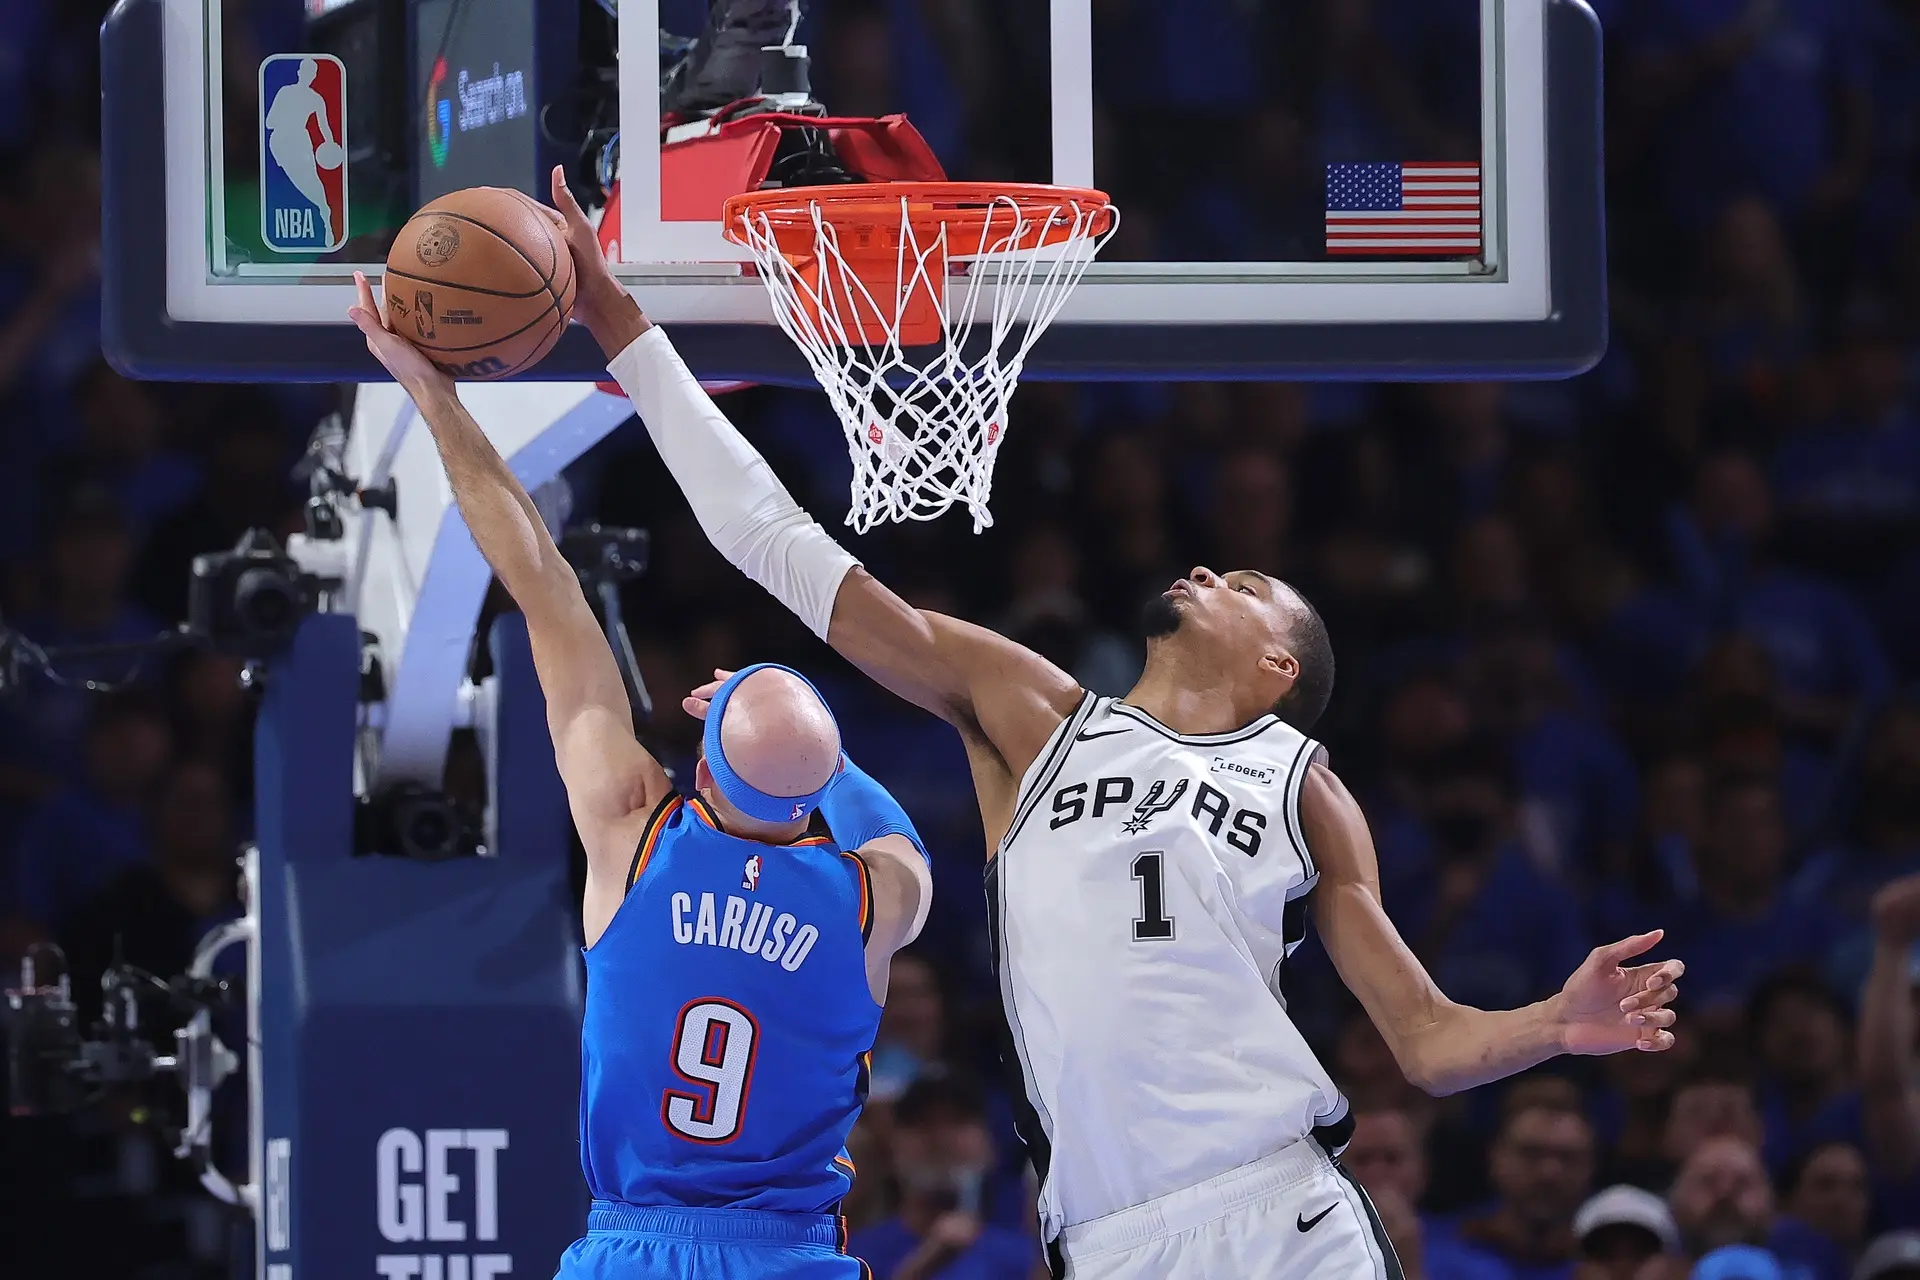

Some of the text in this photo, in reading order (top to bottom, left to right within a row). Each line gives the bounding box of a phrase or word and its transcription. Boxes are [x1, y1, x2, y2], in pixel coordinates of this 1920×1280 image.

[275, 208, 315, 240] NBA
[1220, 762, 1265, 779] LEDGER
[1050, 777, 1267, 858] SPURS
[671, 892, 819, 973] CARUSO
[1130, 851, 1175, 942] 1
[660, 996, 760, 1147] 9
[376, 1127, 509, 1243] GET
